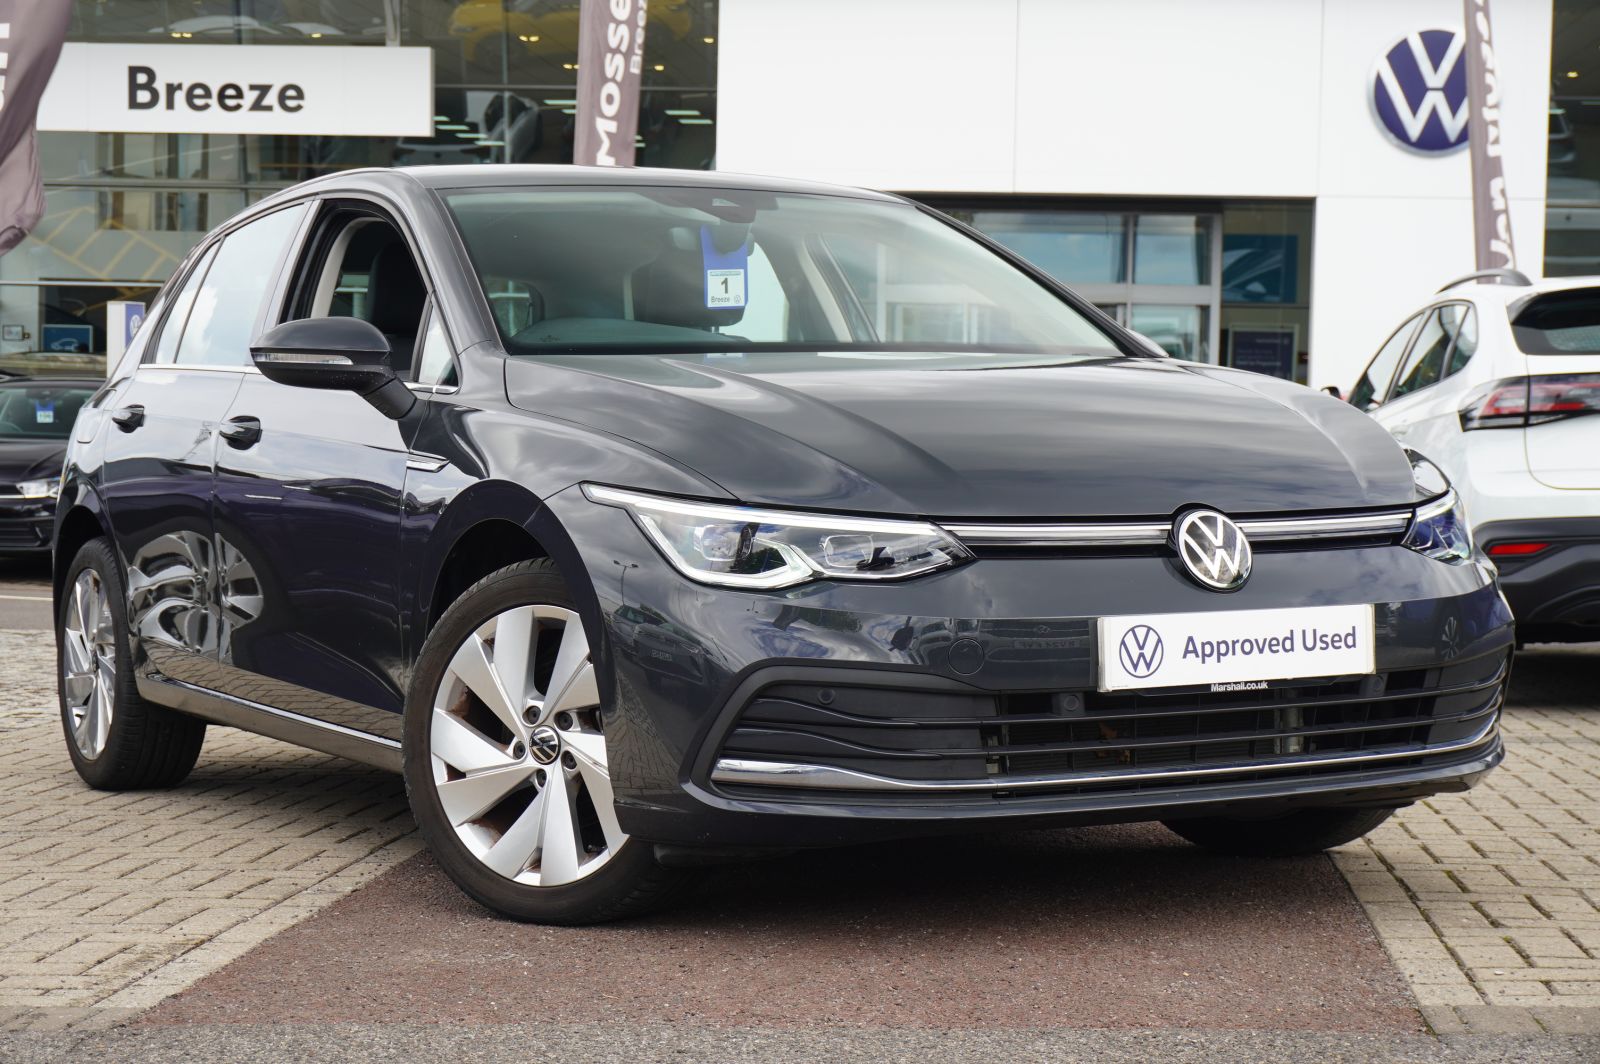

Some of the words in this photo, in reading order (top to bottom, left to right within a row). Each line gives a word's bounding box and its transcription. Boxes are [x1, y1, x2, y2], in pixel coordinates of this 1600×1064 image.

[128, 65, 305, 113] Breeze
[720, 277, 729, 294] 1
[1182, 630, 1295, 664] Approved
[1301, 626, 1357, 653] Used
[1210, 681, 1269, 692] Marshall.co.uk
